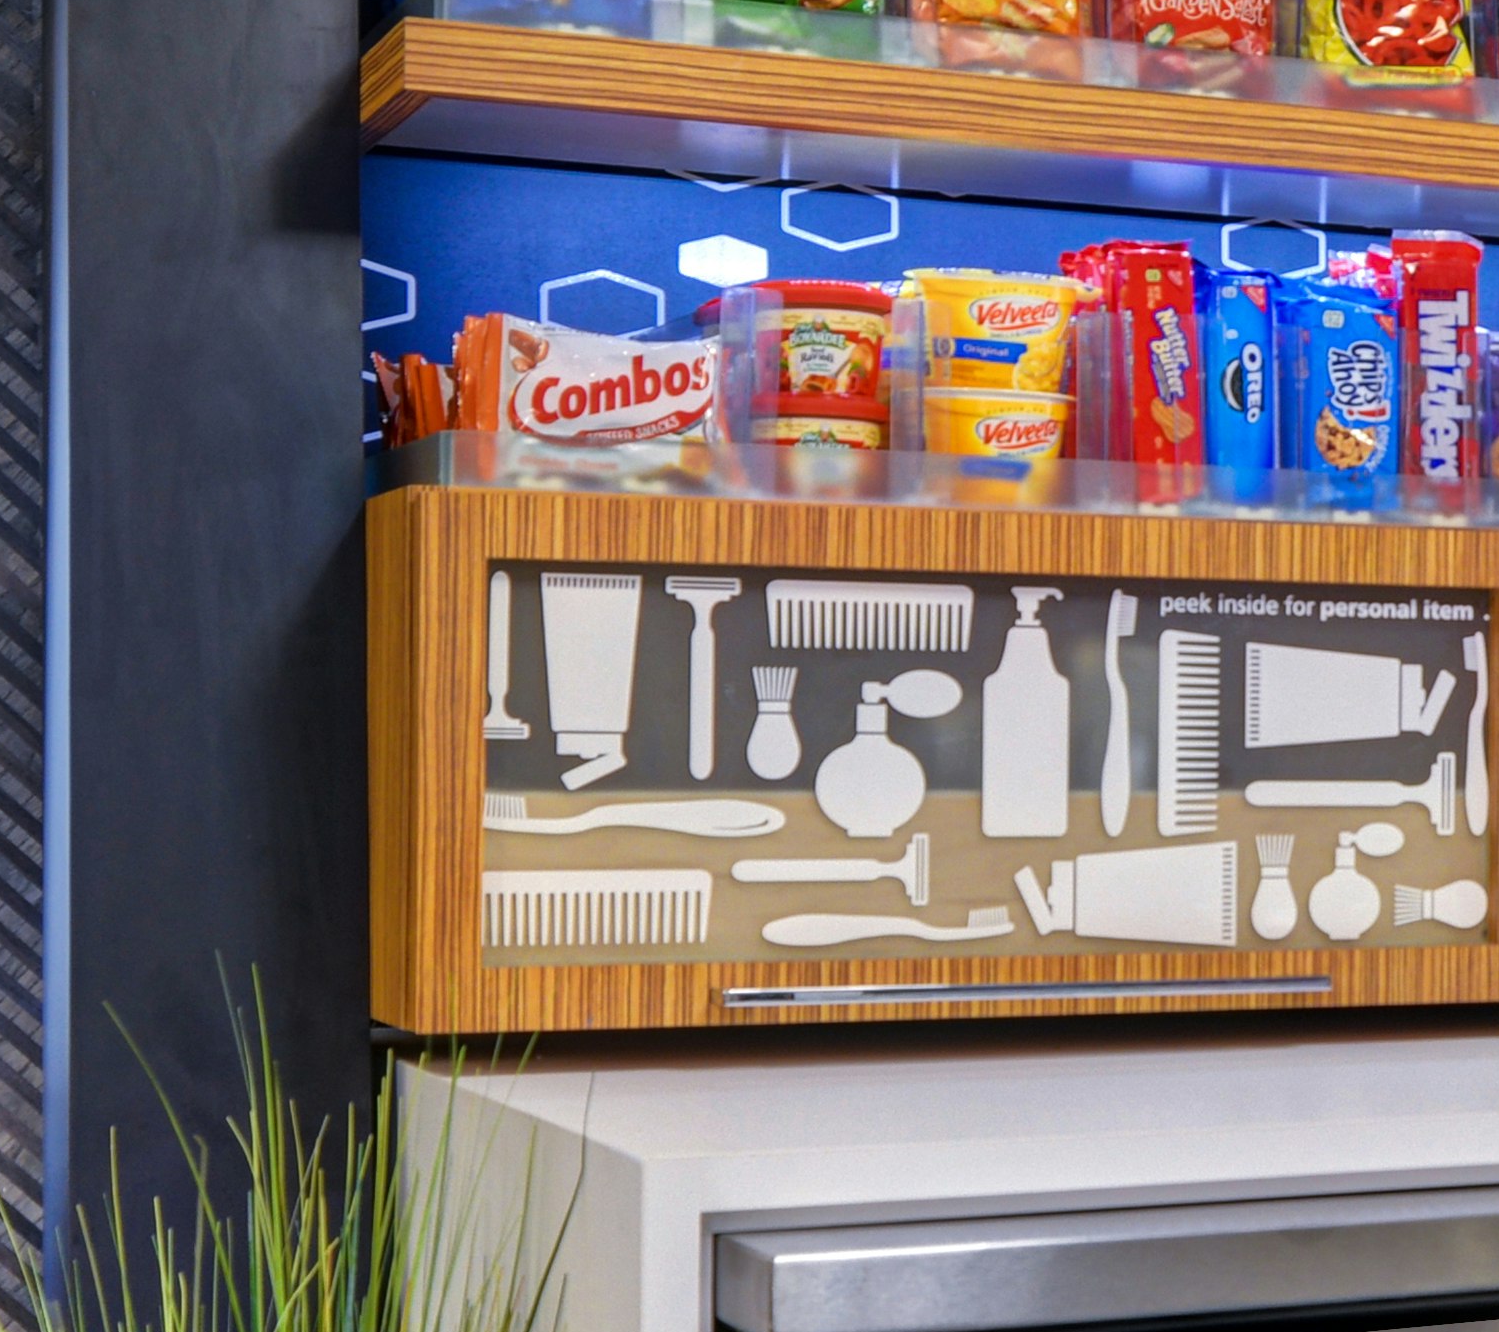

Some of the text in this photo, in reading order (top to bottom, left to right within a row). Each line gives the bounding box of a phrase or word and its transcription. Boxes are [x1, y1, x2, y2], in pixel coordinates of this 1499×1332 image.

[977, 299, 1060, 327] Velveeta
[963, 343, 1009, 358] Original
[1151, 307, 1190, 399] Nutter Butter
[531, 355, 710, 425] Combos
[1241, 342, 1263, 424] OREO
[1351, 342, 1384, 406] Chips
[983, 418, 1059, 445] Velveeta
[1160, 593, 1211, 617] peek
[1218, 594, 1279, 616] inside
[1284, 595, 1315, 616] for
[1320, 598, 1417, 622] personal
